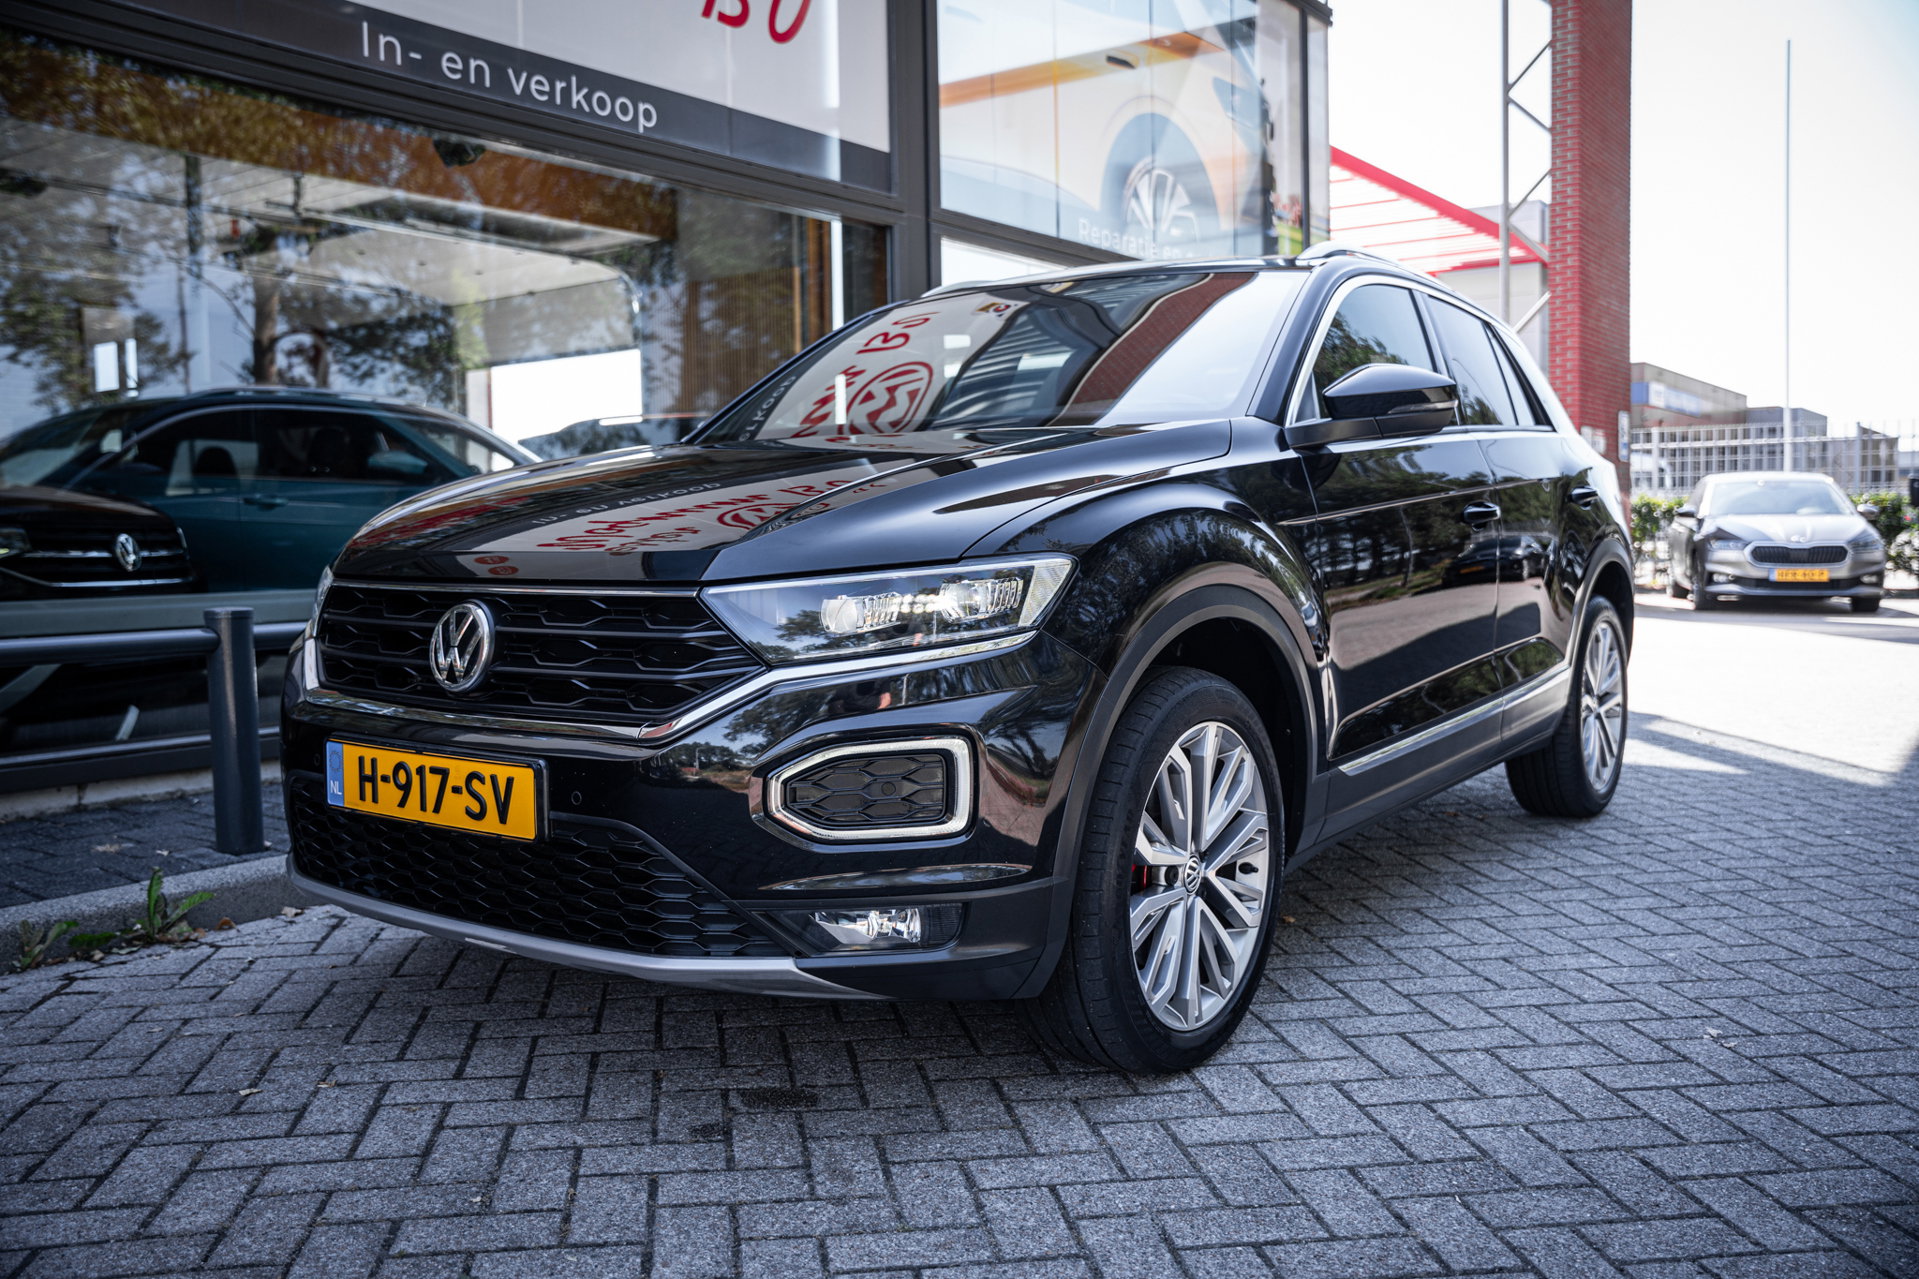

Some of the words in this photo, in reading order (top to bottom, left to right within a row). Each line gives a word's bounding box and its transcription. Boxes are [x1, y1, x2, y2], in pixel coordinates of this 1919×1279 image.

[361, 20, 423, 66] In-
[440, 48, 491, 89] en
[506, 67, 659, 134] verkoop
[330, 780, 342, 796] NL
[358, 755, 515, 825] H-917-SV
